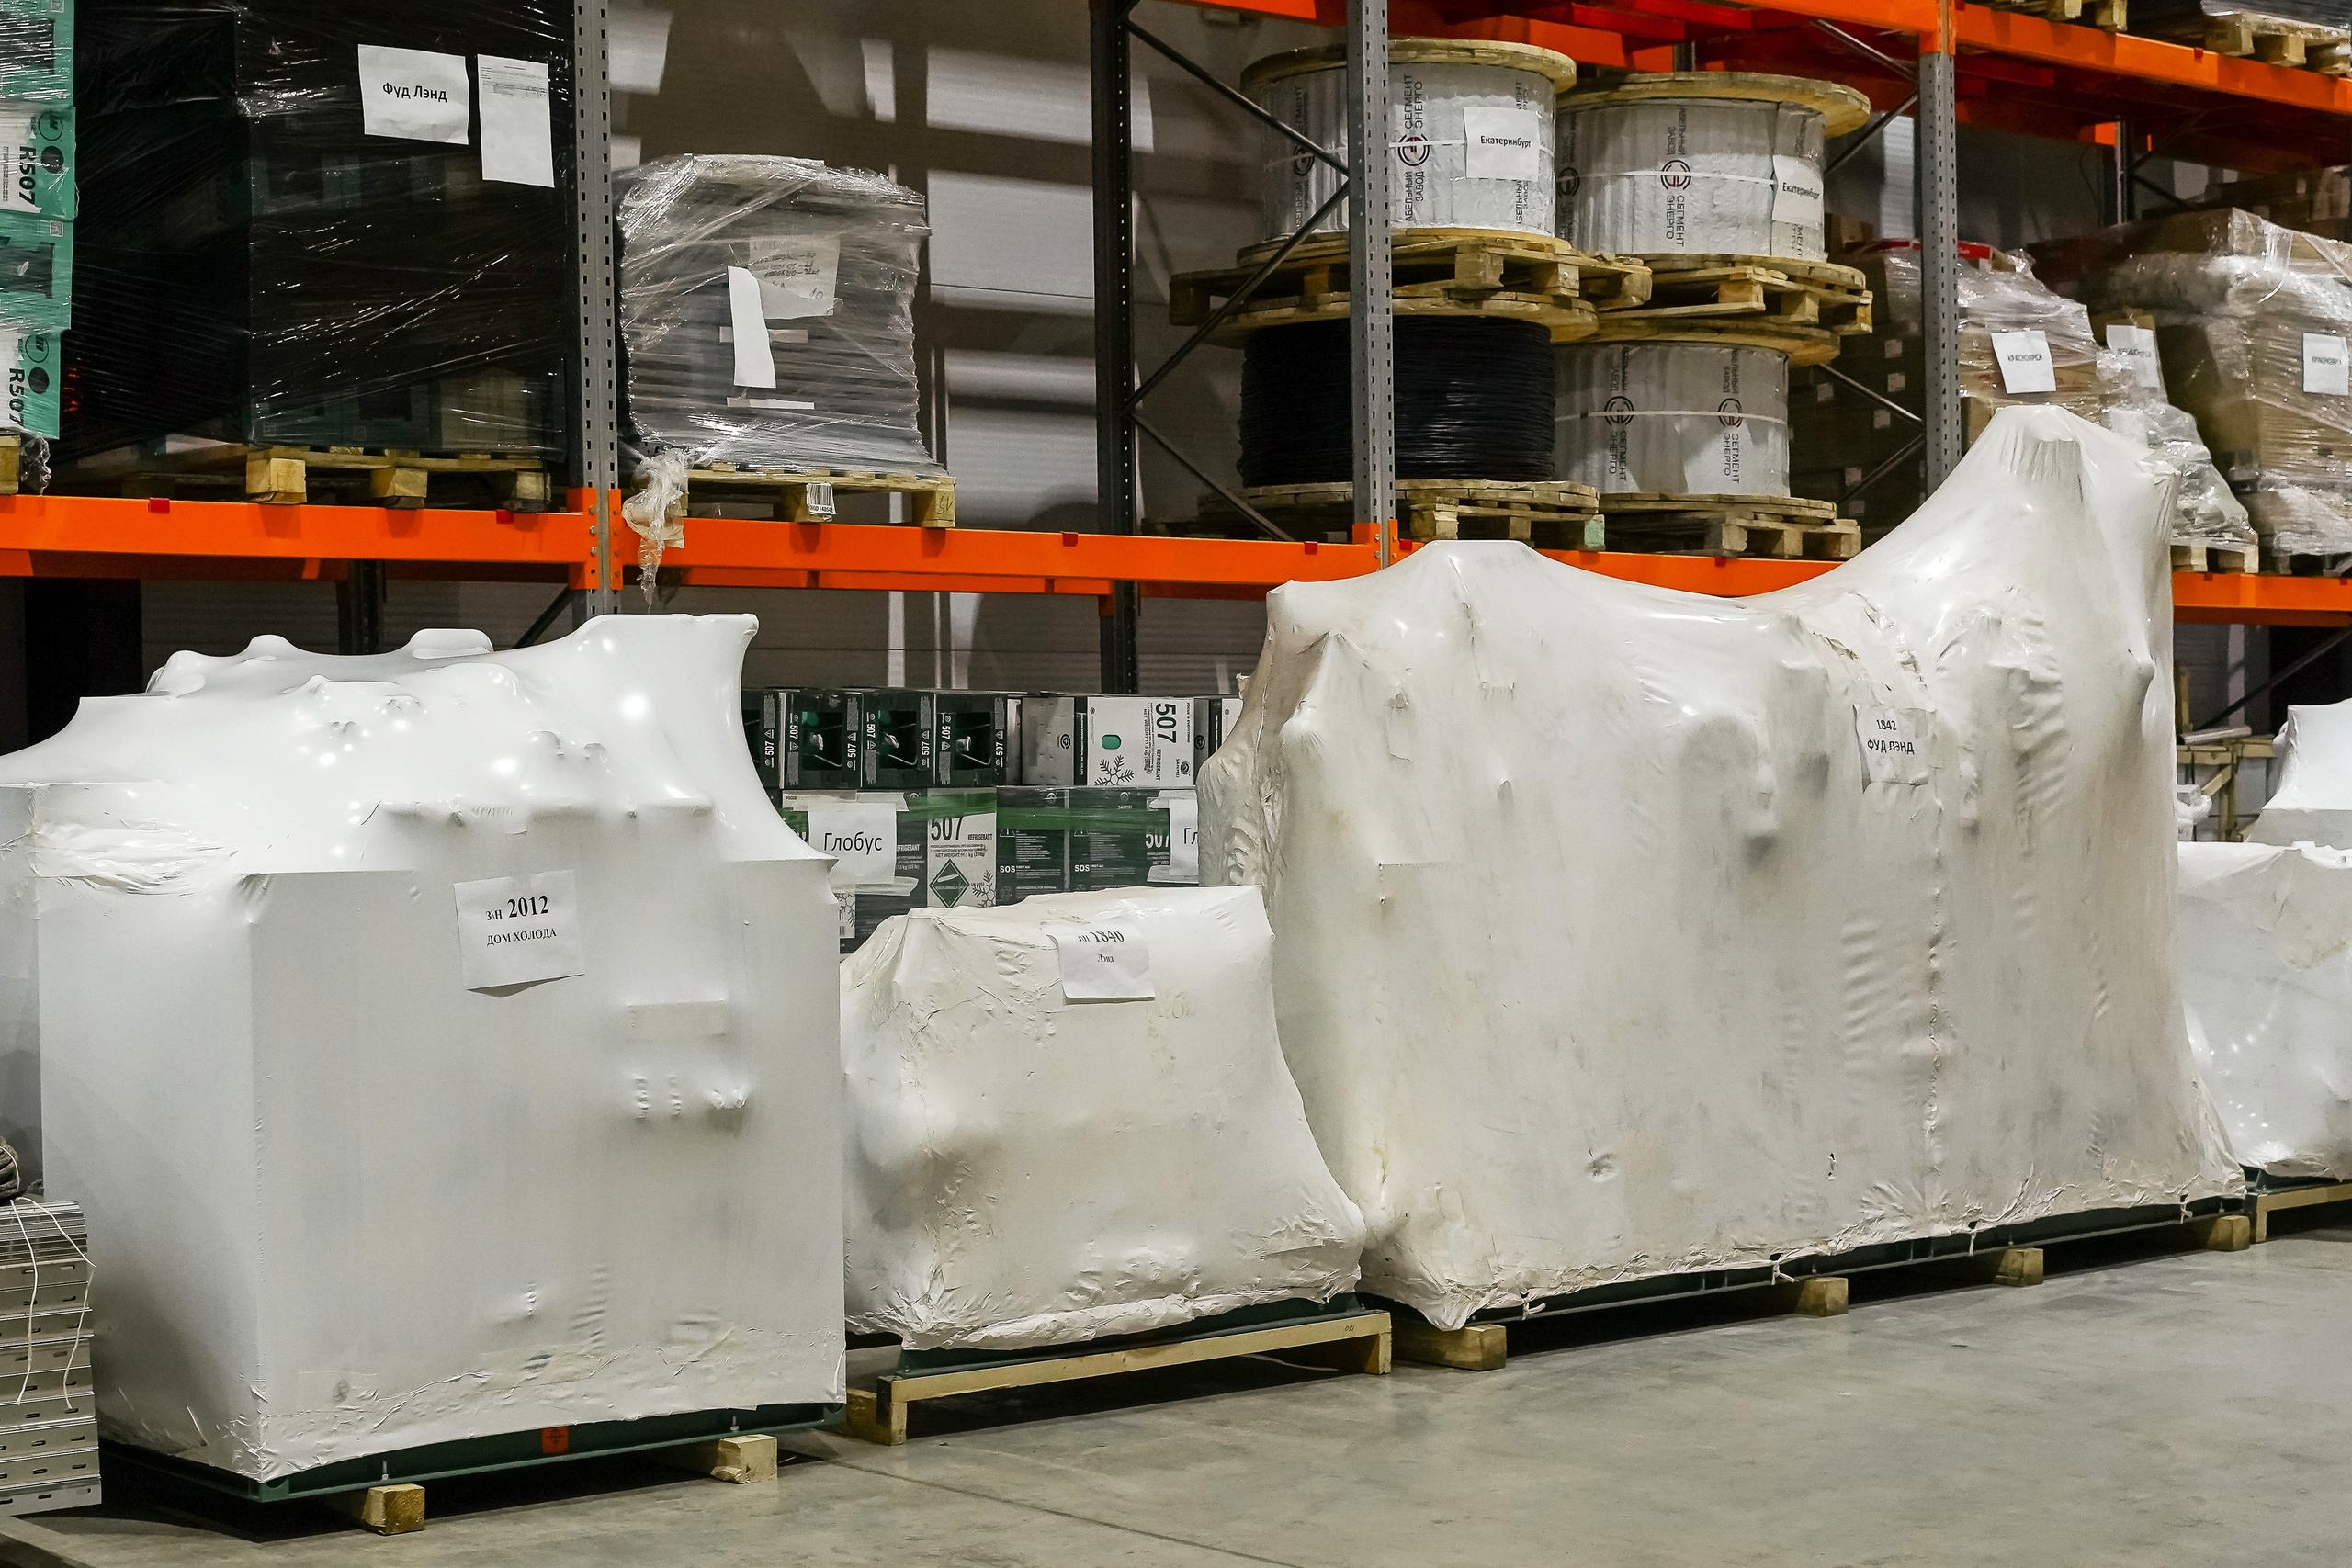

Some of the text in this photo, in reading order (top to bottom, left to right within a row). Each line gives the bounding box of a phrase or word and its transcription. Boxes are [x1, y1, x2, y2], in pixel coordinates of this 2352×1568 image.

[382, 82, 447, 103] Фуд Лэнд
[1404, 74, 1413, 129] СЕГМЕНТ
[1414, 81, 1423, 129] ЭНЕРГО
[1480, 135, 1532, 149] Екатеринбург
[18, 146, 36, 205] R507
[1415, 171, 1424, 202] ЗАВОД
[1403, 171, 1413, 222] АБЕЛЬНЫЙ
[1666, 195, 1675, 240] ЭНЕРГО
[1677, 195, 1685, 247] СЕГМЕНТ
[1731, 348, 1740, 394] АБЕЛЬНЫЙ
[8, 367, 25, 429] R507
[1608, 431, 1618, 475] ЭНЕРГО
[1618, 430, 1628, 482] СЕГМЕНТ
[1723, 433, 1732, 477] ЭНЕРГО
[1731, 433, 1740, 484] СЕГМЕНТ
[790, 725, 798, 739] 507
[866, 724, 876, 738] 507
[942, 726, 951, 740] 507
[1155, 703, 1177, 744] 507
[1876, 719, 1897, 731] 1842
[764, 740, 775, 756] 507
[847, 743, 857, 758] 507
[921, 741, 930, 756] 507
[996, 741, 1004, 756] 507
[1867, 739, 1915, 755] ФУД ЛЭНД
[931, 816, 964, 841] 507
[823, 831, 883, 855] Глобус
[897, 843, 921, 852] EFRIGERANT
[1000, 865, 1016, 874] SOS
[1074, 864, 1091, 873] SOS
[507, 895, 549, 918] 2012
[486, 928, 557, 947] ДОМ ХОЛОДА
[1090, 930, 1125, 942] 1840
